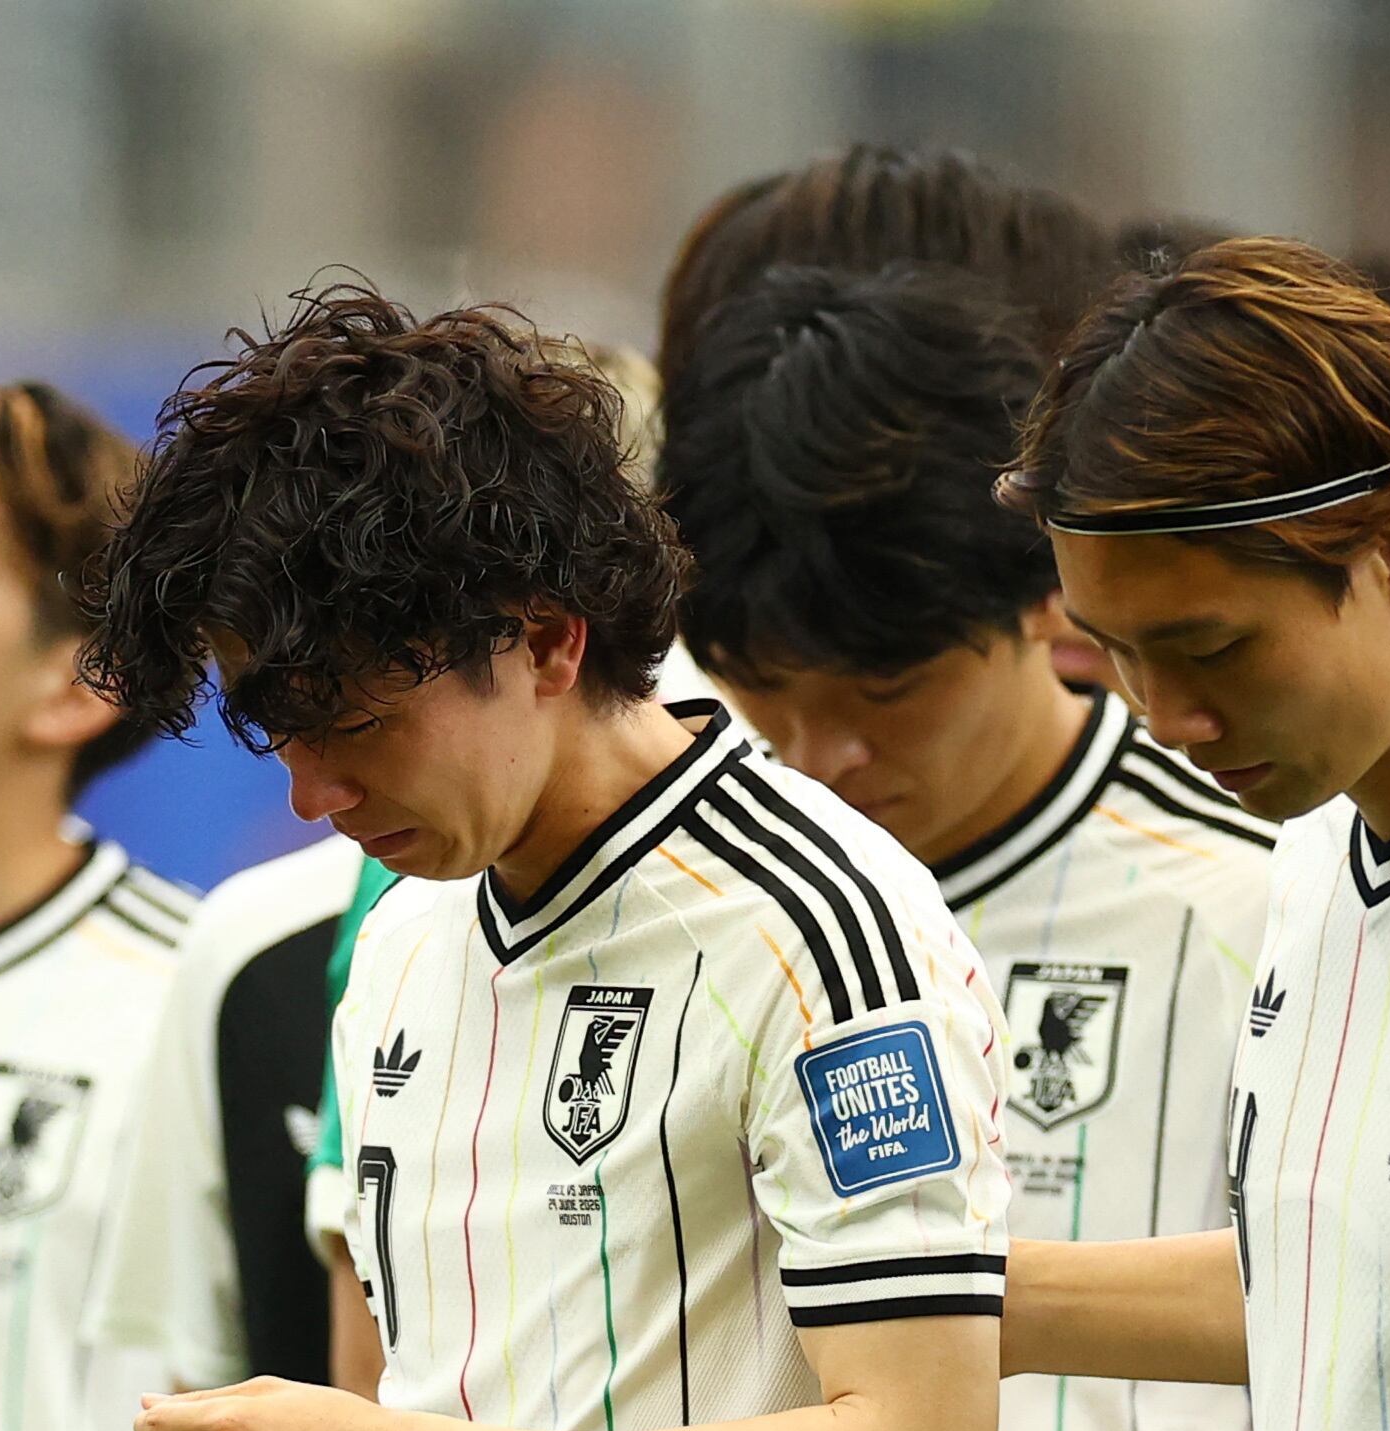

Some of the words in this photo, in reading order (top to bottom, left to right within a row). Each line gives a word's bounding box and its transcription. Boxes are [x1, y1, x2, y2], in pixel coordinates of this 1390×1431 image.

[586, 990, 633, 1005] JAPAN
[825, 1050, 912, 1092] FOOTBALL
[831, 1073, 920, 1121] UNITES
[562, 1106, 601, 1134] JFA
[835, 1122, 870, 1151] the
[870, 1104, 930, 1140] World
[868, 1141, 907, 1161] FIFA
[567, 1184, 576, 1196] VS
[578, 1184, 604, 1196] JAPAN
[548, 1198, 557, 1210] 29
[559, 1198, 578, 1211] JUNE
[579, 1199, 601, 1211] 2026
[559, 1213, 592, 1226] HOUSTON
[358, 1145, 401, 1354] 7
